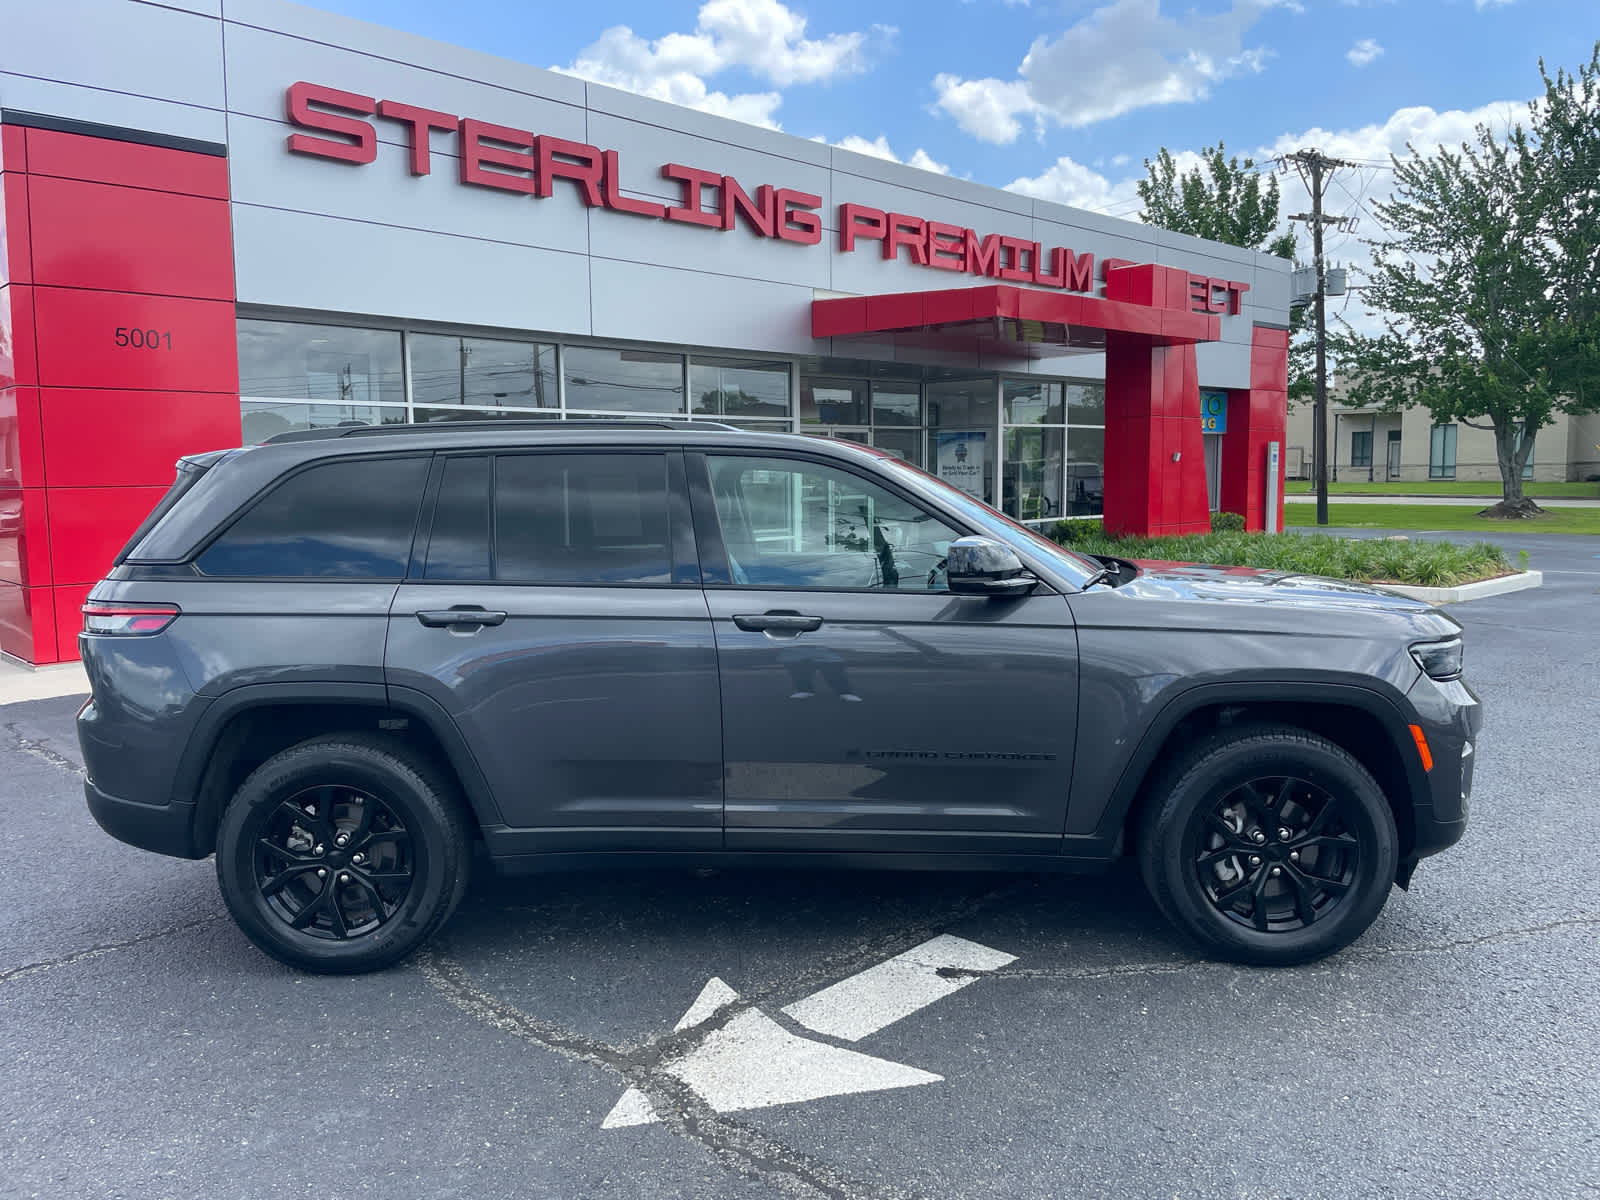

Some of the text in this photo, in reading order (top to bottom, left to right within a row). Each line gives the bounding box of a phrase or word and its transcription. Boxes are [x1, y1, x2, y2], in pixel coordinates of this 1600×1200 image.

[286, 80, 822, 246] STERLING
[839, 202, 1094, 293] PREMIUM
[115, 326, 172, 351] 5001
[943, 752, 1057, 761] CHEROKEE
